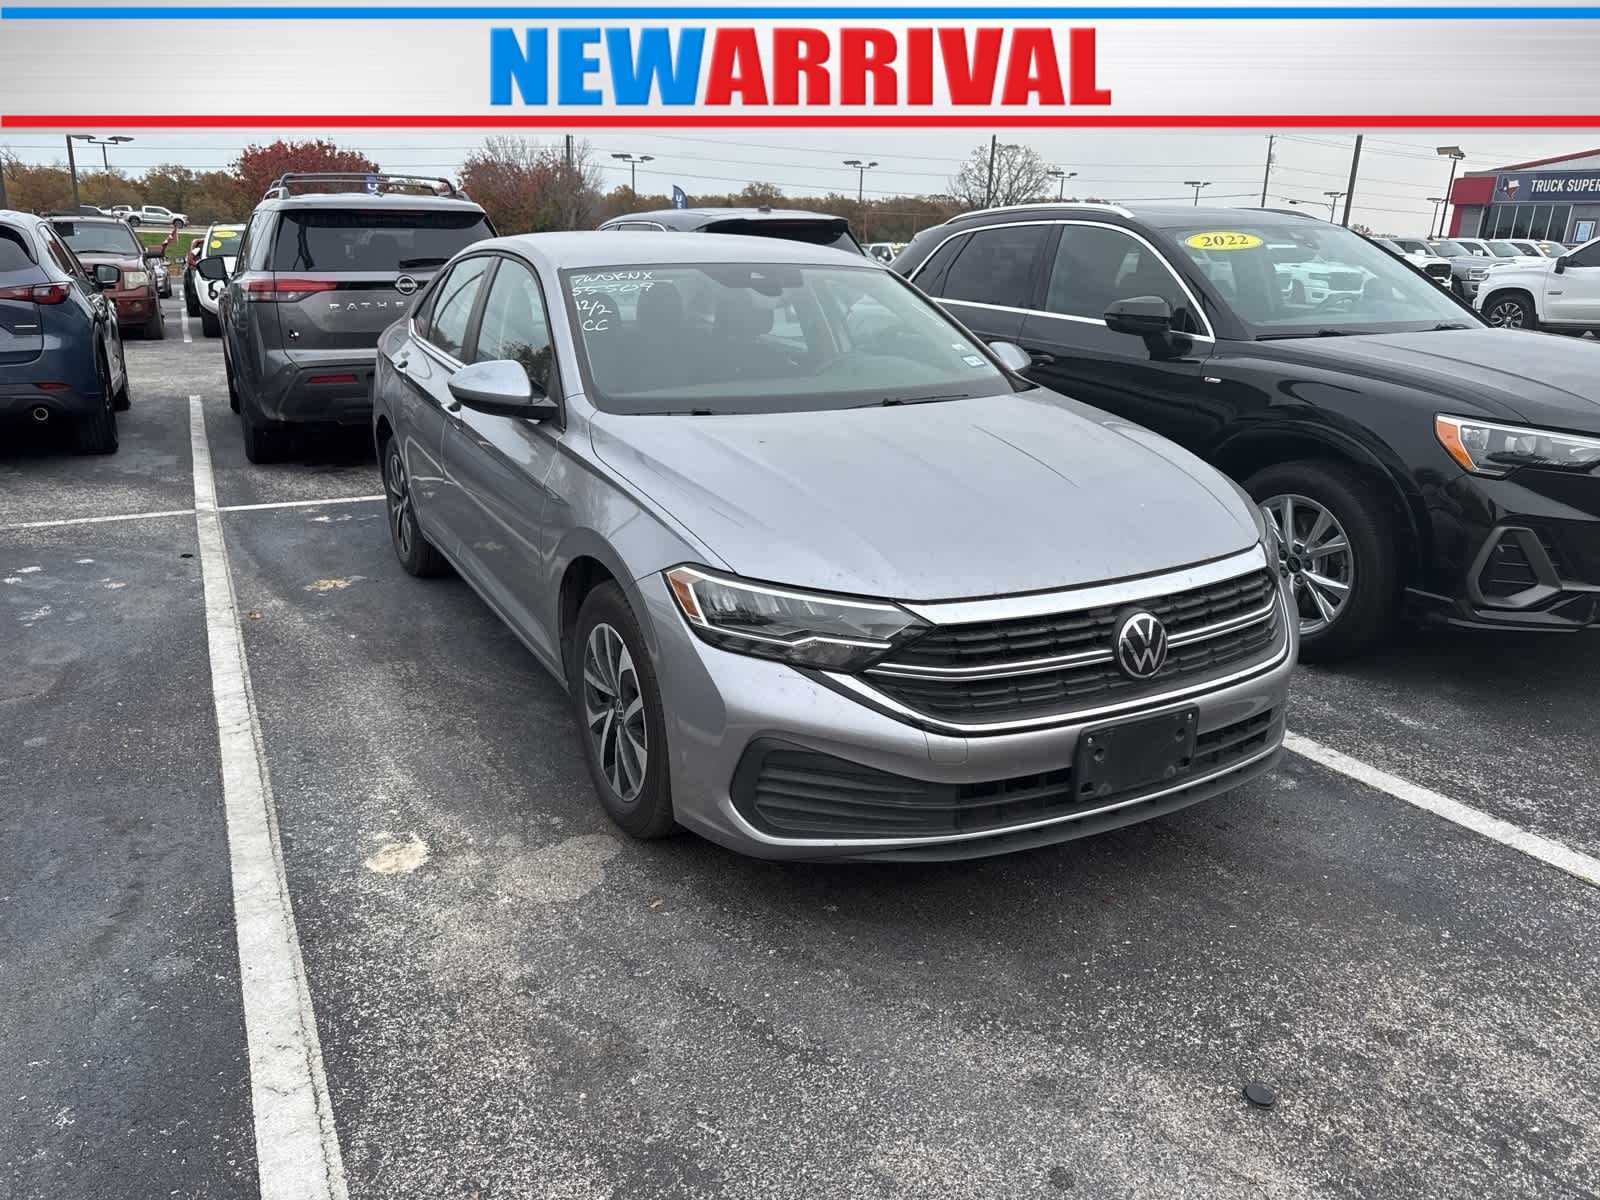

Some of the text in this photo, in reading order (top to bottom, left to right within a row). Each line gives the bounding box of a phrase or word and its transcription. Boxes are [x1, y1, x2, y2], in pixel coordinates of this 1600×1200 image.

[1531, 178, 1600, 193] TRUCK SUPER
[1201, 234, 1249, 248] 2022
[575, 299, 613, 317] 12/2
